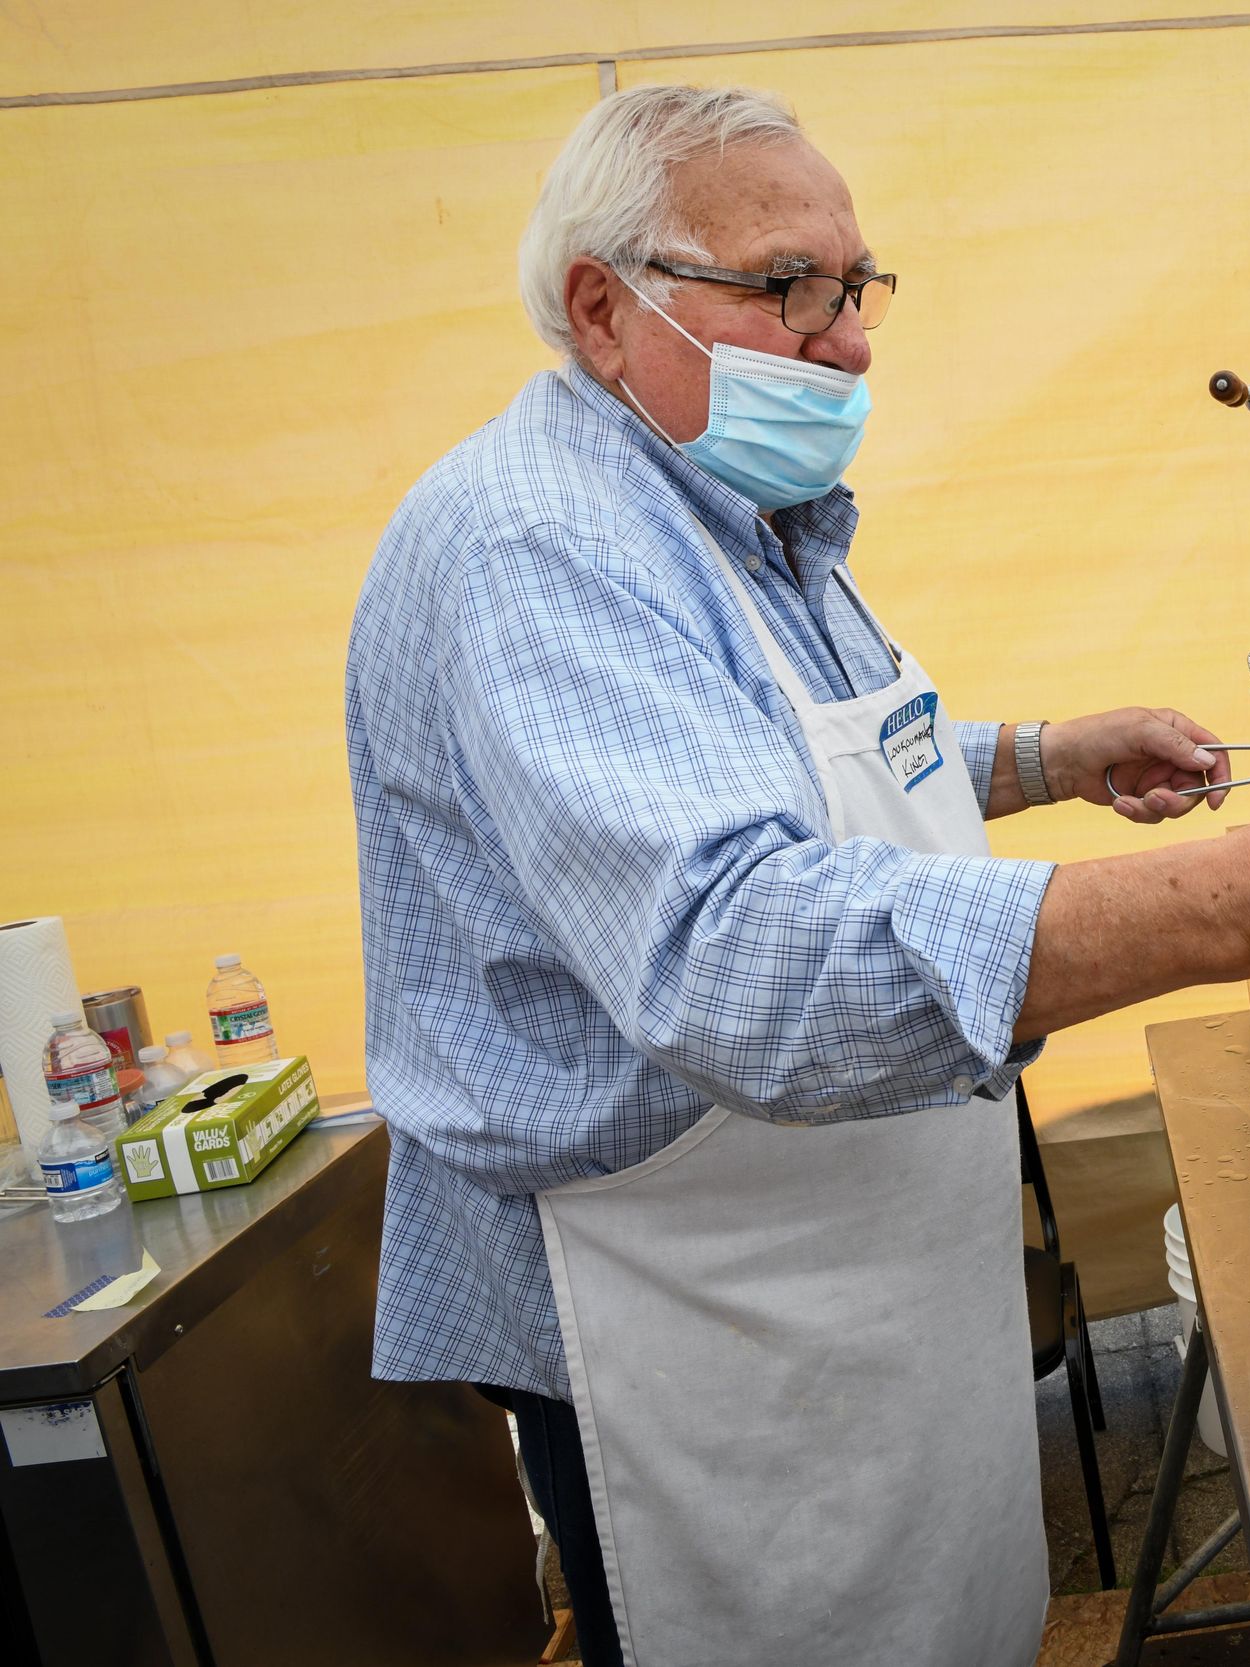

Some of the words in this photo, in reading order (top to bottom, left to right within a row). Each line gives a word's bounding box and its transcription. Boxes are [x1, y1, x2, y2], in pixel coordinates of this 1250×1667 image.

[887, 697, 924, 735] HELLO
[902, 753, 928, 778] KING
[192, 1127, 219, 1140] VALU
[194, 1136, 230, 1152] GARDS
